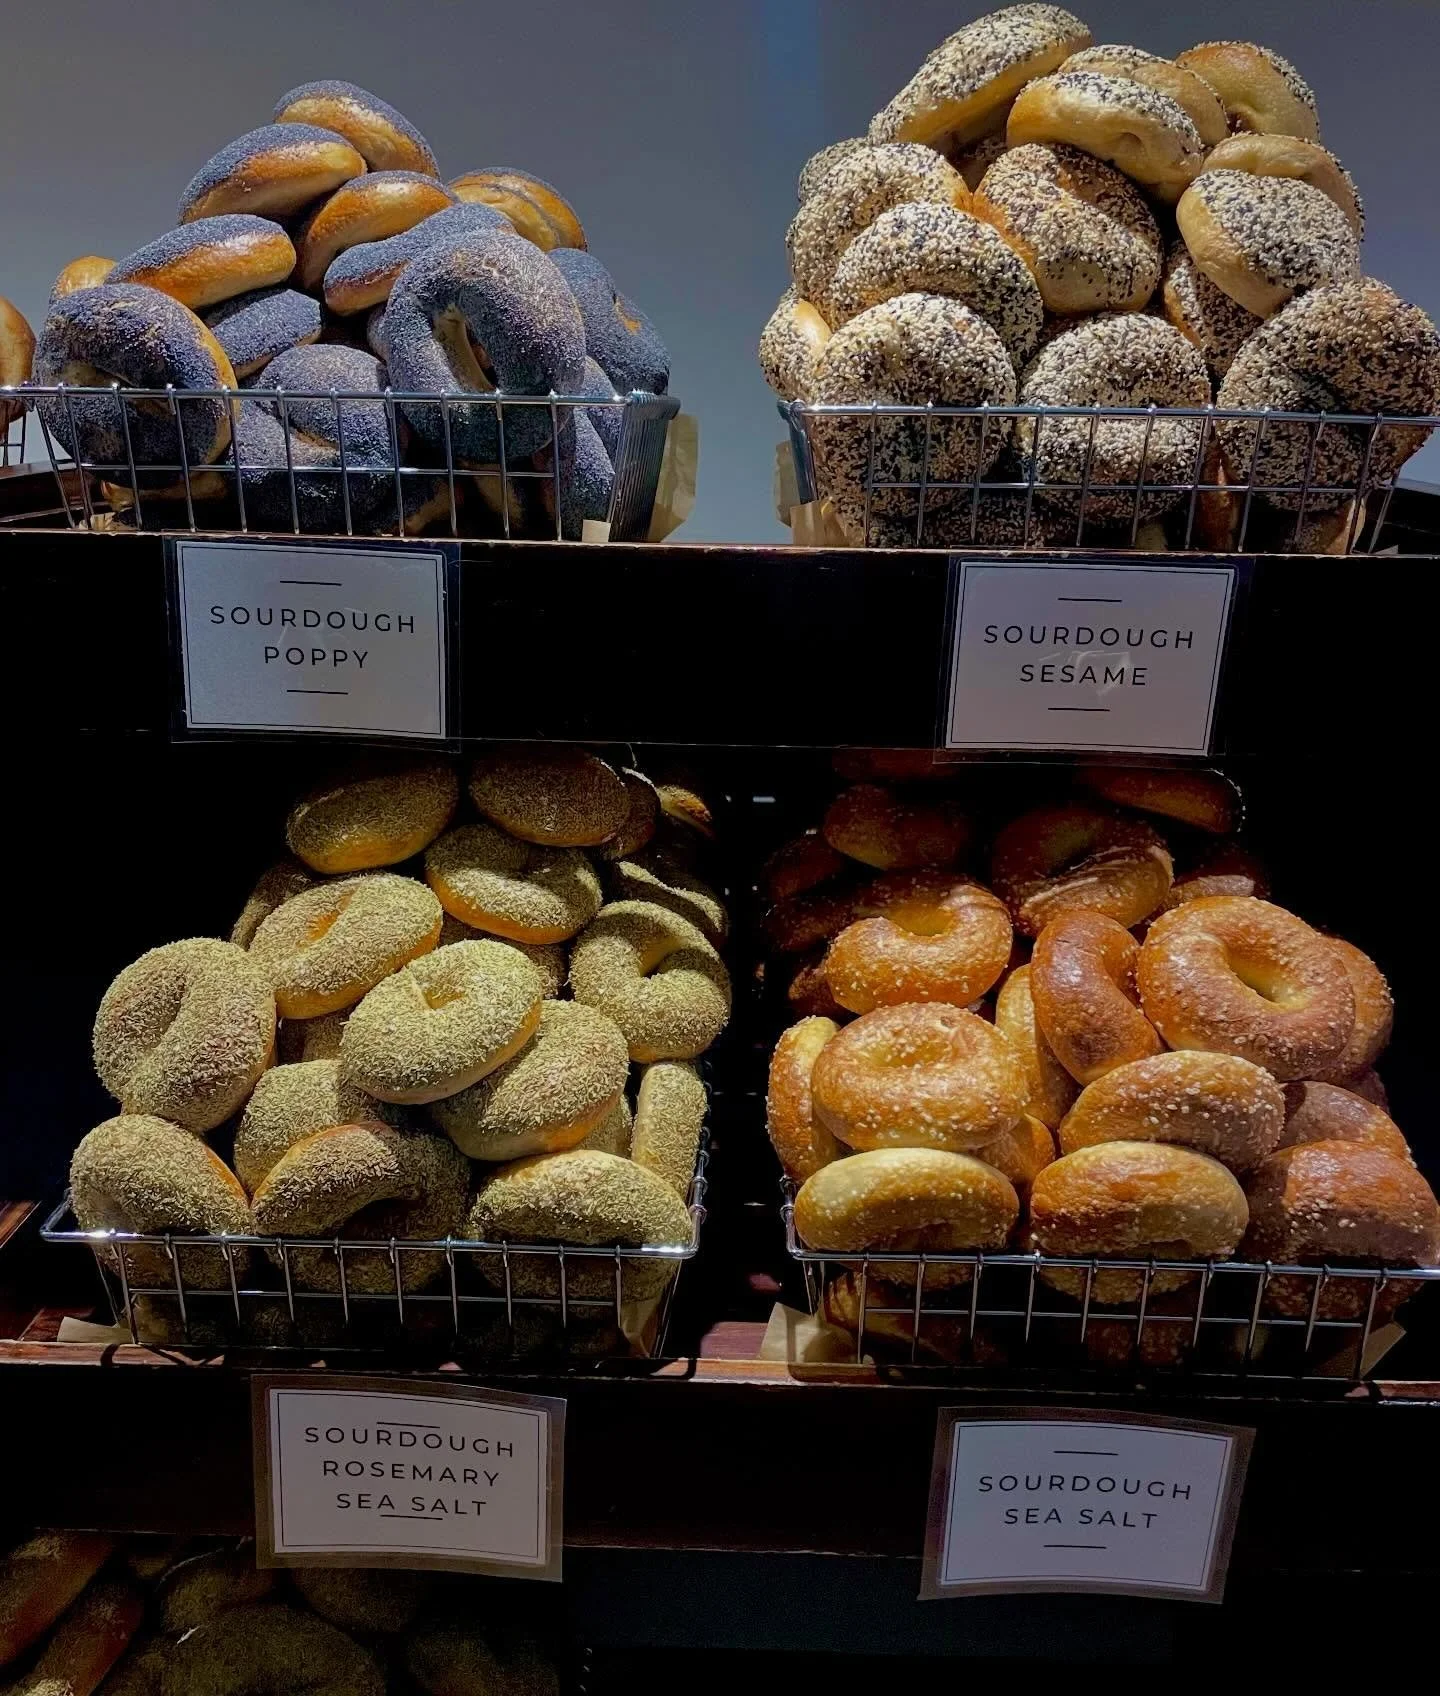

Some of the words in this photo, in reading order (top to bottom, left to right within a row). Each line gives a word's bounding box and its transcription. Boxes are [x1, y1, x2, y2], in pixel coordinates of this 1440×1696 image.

[210, 606, 414, 634] SOURDOUGH
[984, 625, 1194, 649] SOURDOUGH
[265, 647, 369, 668] POPPY
[1020, 665, 1148, 685] SESAME
[306, 1427, 513, 1457] SOURDOUGH
[324, 1461, 499, 1486] ROSEMARY
[979, 1475, 1191, 1500] SOURDOUGH
[337, 1494, 395, 1511] SEA
[411, 1496, 487, 1516] SALT
[1005, 1508, 1063, 1525] SEA
[1079, 1508, 1158, 1529] SALT
